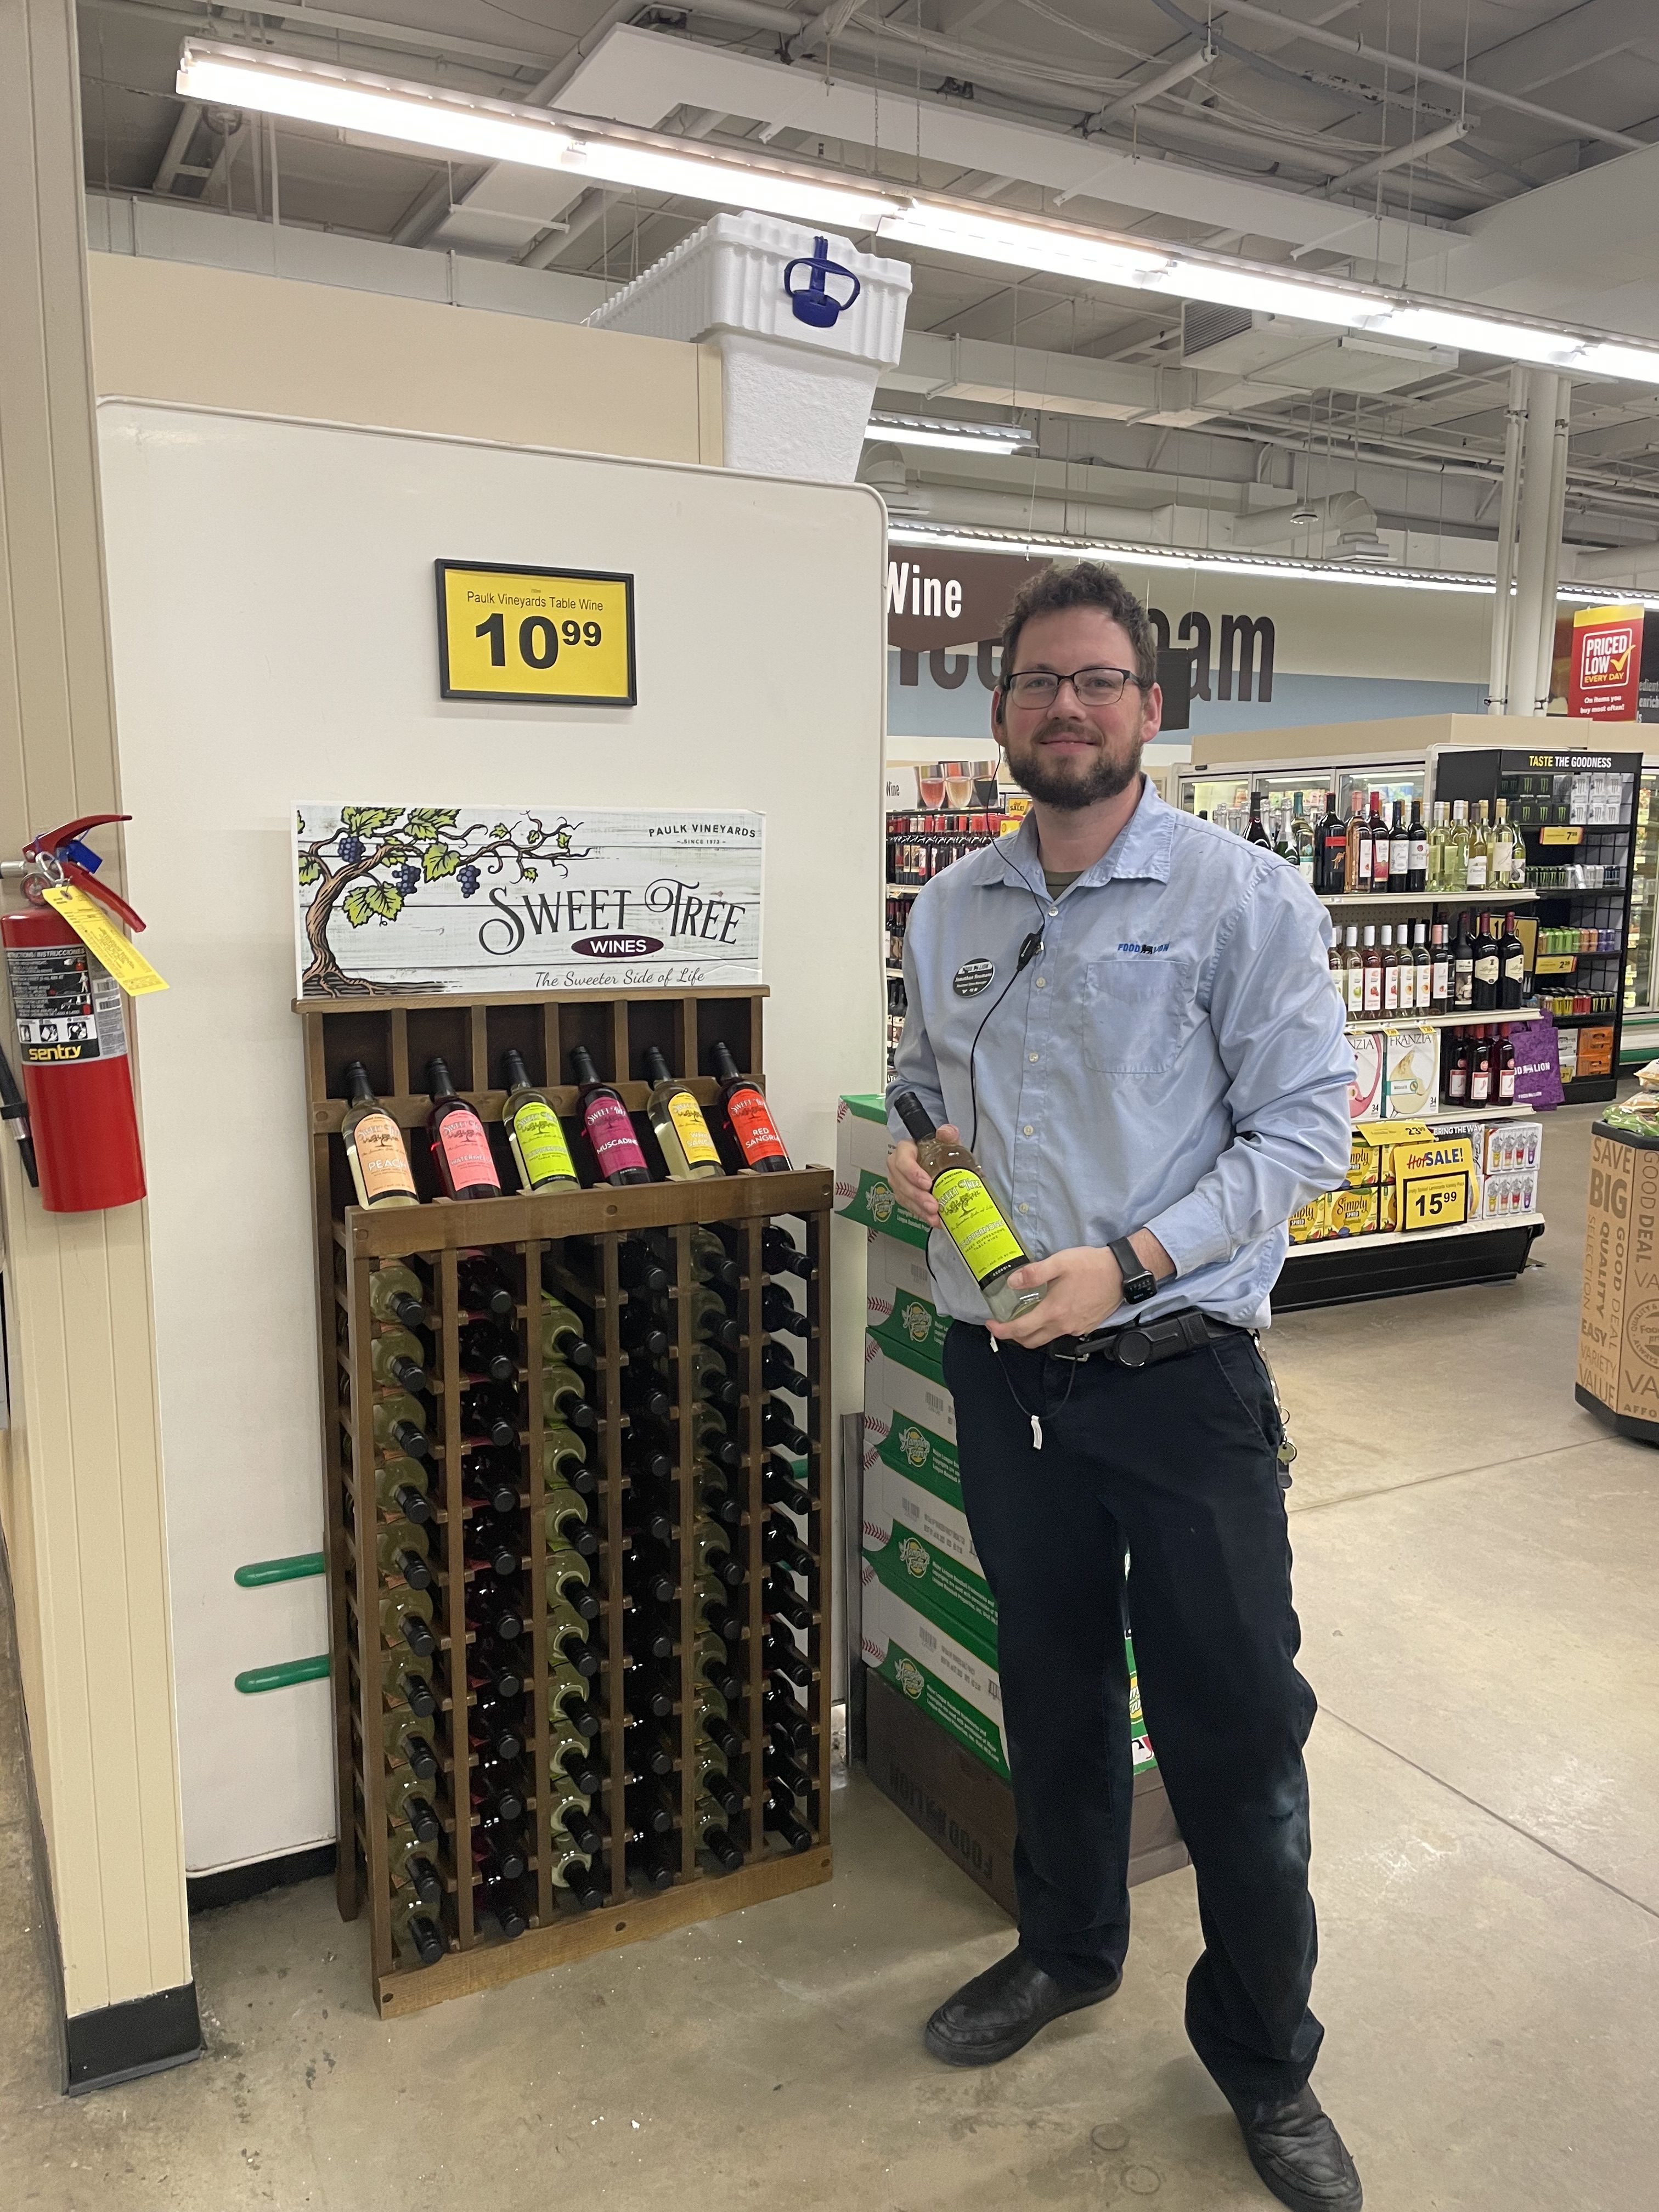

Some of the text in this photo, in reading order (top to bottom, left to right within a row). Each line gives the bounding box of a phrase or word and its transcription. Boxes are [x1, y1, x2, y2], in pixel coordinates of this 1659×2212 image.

[888, 562, 962, 618] Wine
[467, 591, 603, 611] Paulk Vineyards Table Wine
[1587, 635, 1627, 657] PRICED
[1585, 656, 1610, 675] LOW
[1584, 672, 1624, 683] EVERY DAY
[1607, 704, 1624, 712] often!
[1529, 755, 1612, 768] TASTE THE GOODNESS
[649, 824, 755, 838] PAULK VINEYARDS
[590, 940, 647, 954] WINES
[1118, 944, 1140, 952] FOOD
[535, 967, 704, 988] The Sweeter Side of Life
[1390, 1034, 1431, 1048] FRANZIA
[29, 1044, 81, 1060] sentry
[1533, 1062, 1550, 1072] LION
[745, 1135, 781, 1148] SANGRIA
[753, 1127, 769, 1136] RED
[1434, 1127, 1454, 1136] BRING
[596, 1138, 638, 1154] MUSCADINE
[1593, 1136, 1632, 1174] SAVE
[1407, 1148, 1464, 1170] Hot SALE!
[1641, 1152, 1659, 1209] GOOD
[1590, 1167, 1628, 1219] BIG
[1336, 1196, 1368, 1215] Simply
[1636, 1214, 1655, 1263] DEAL
[992, 1265, 1011, 1276] GEORGIA
[1596, 1221, 1610, 1319] QUALITY
[1609, 1226, 1625, 1349] GOOD DEAL
[1631, 1305, 1650, 1332] QUALITY
[1582, 1318, 1607, 1347] EASY
[1581, 1342, 1617, 1379] VARIETY
[1633, 1339, 1658, 1364] ALWAYS
[1579, 1363, 1615, 1408] VALUE
[1623, 1403, 1657, 1418] AFFO
[899, 1429, 930, 1453] Hampton
[899, 1539, 930, 1564] Hampton
